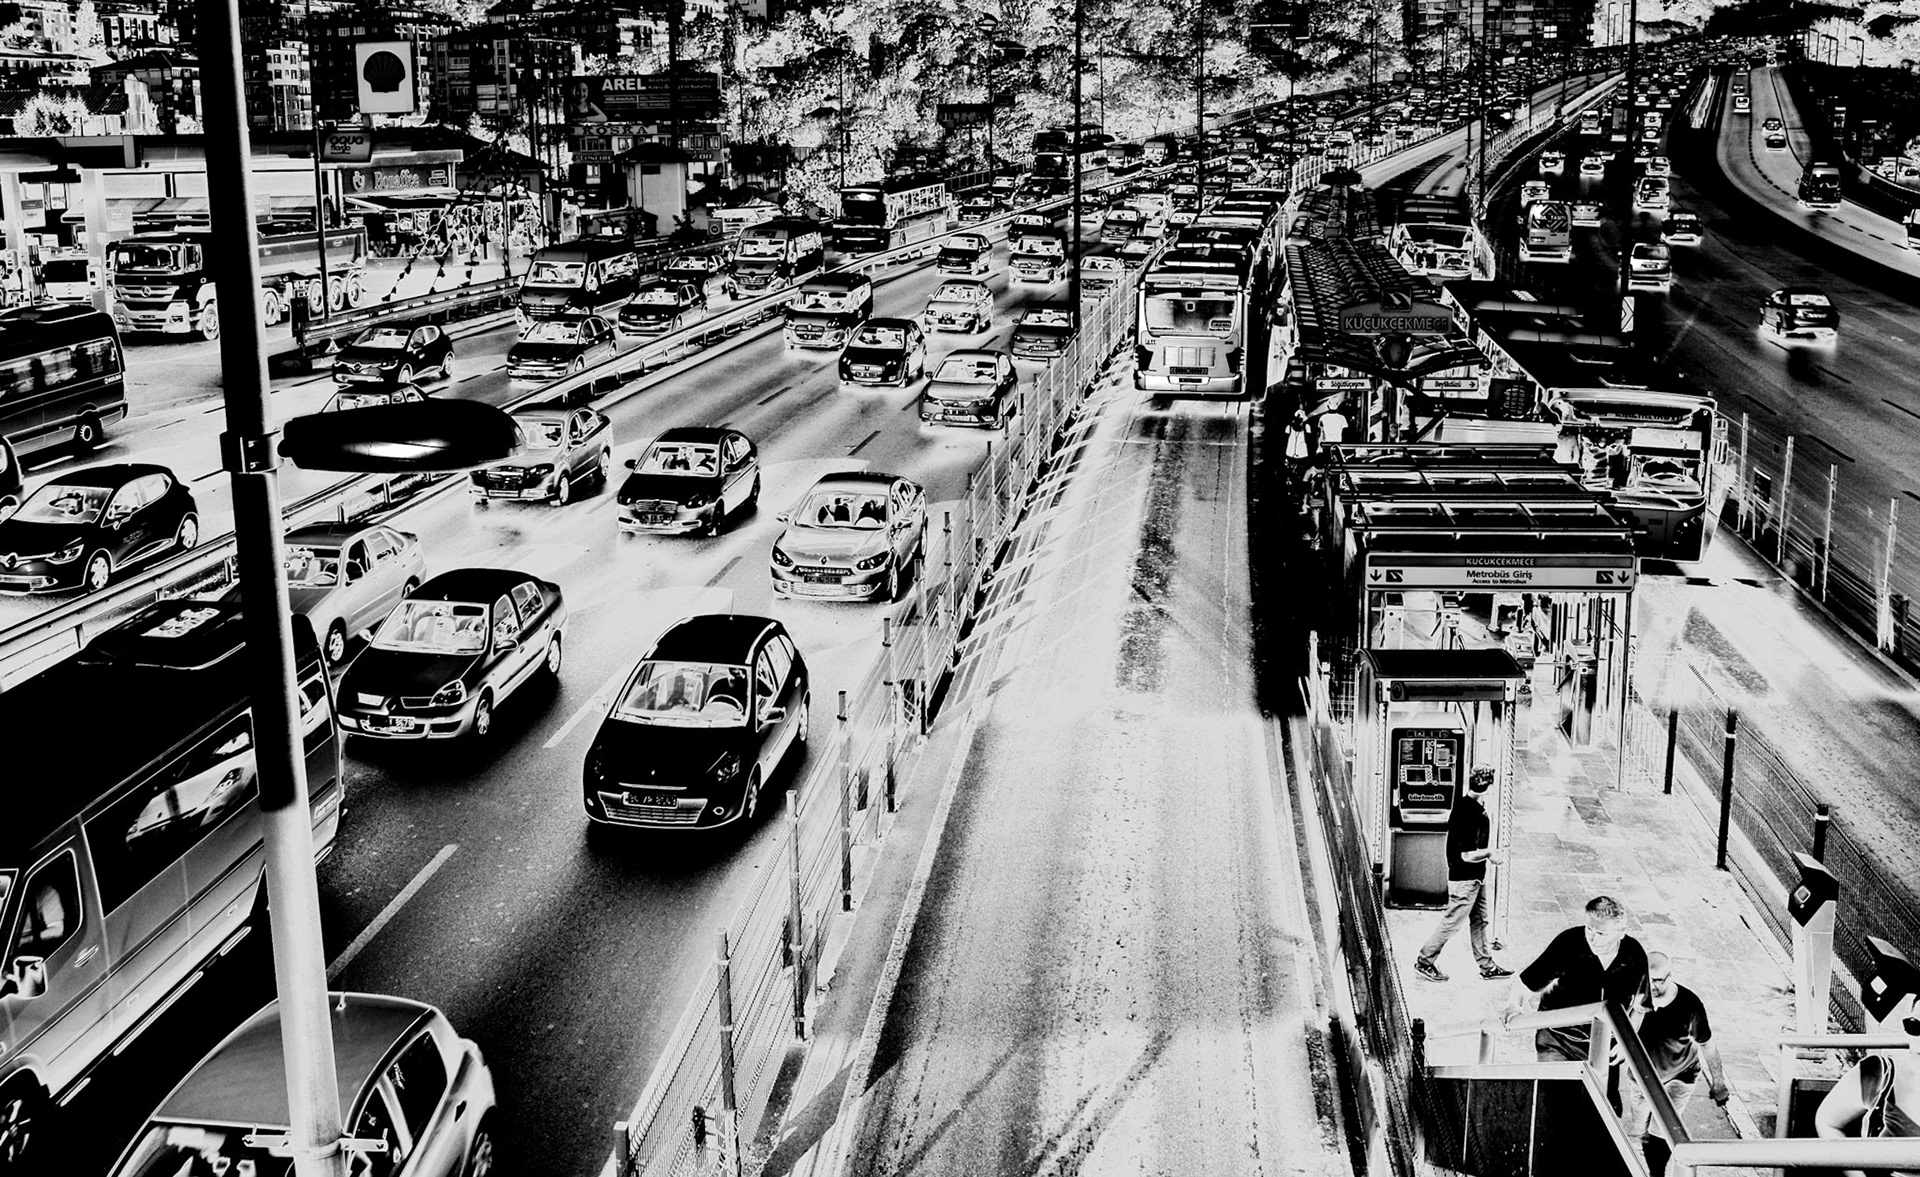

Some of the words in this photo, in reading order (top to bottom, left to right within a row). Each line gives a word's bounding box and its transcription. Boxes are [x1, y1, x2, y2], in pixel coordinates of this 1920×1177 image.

[601, 78, 647, 91] AREL
[582, 125, 649, 135] KOSKA
[329, 135, 364, 147] aqua
[1466, 570, 1510, 578] Metrobüs
[1512, 570, 1533, 580] Giriş
